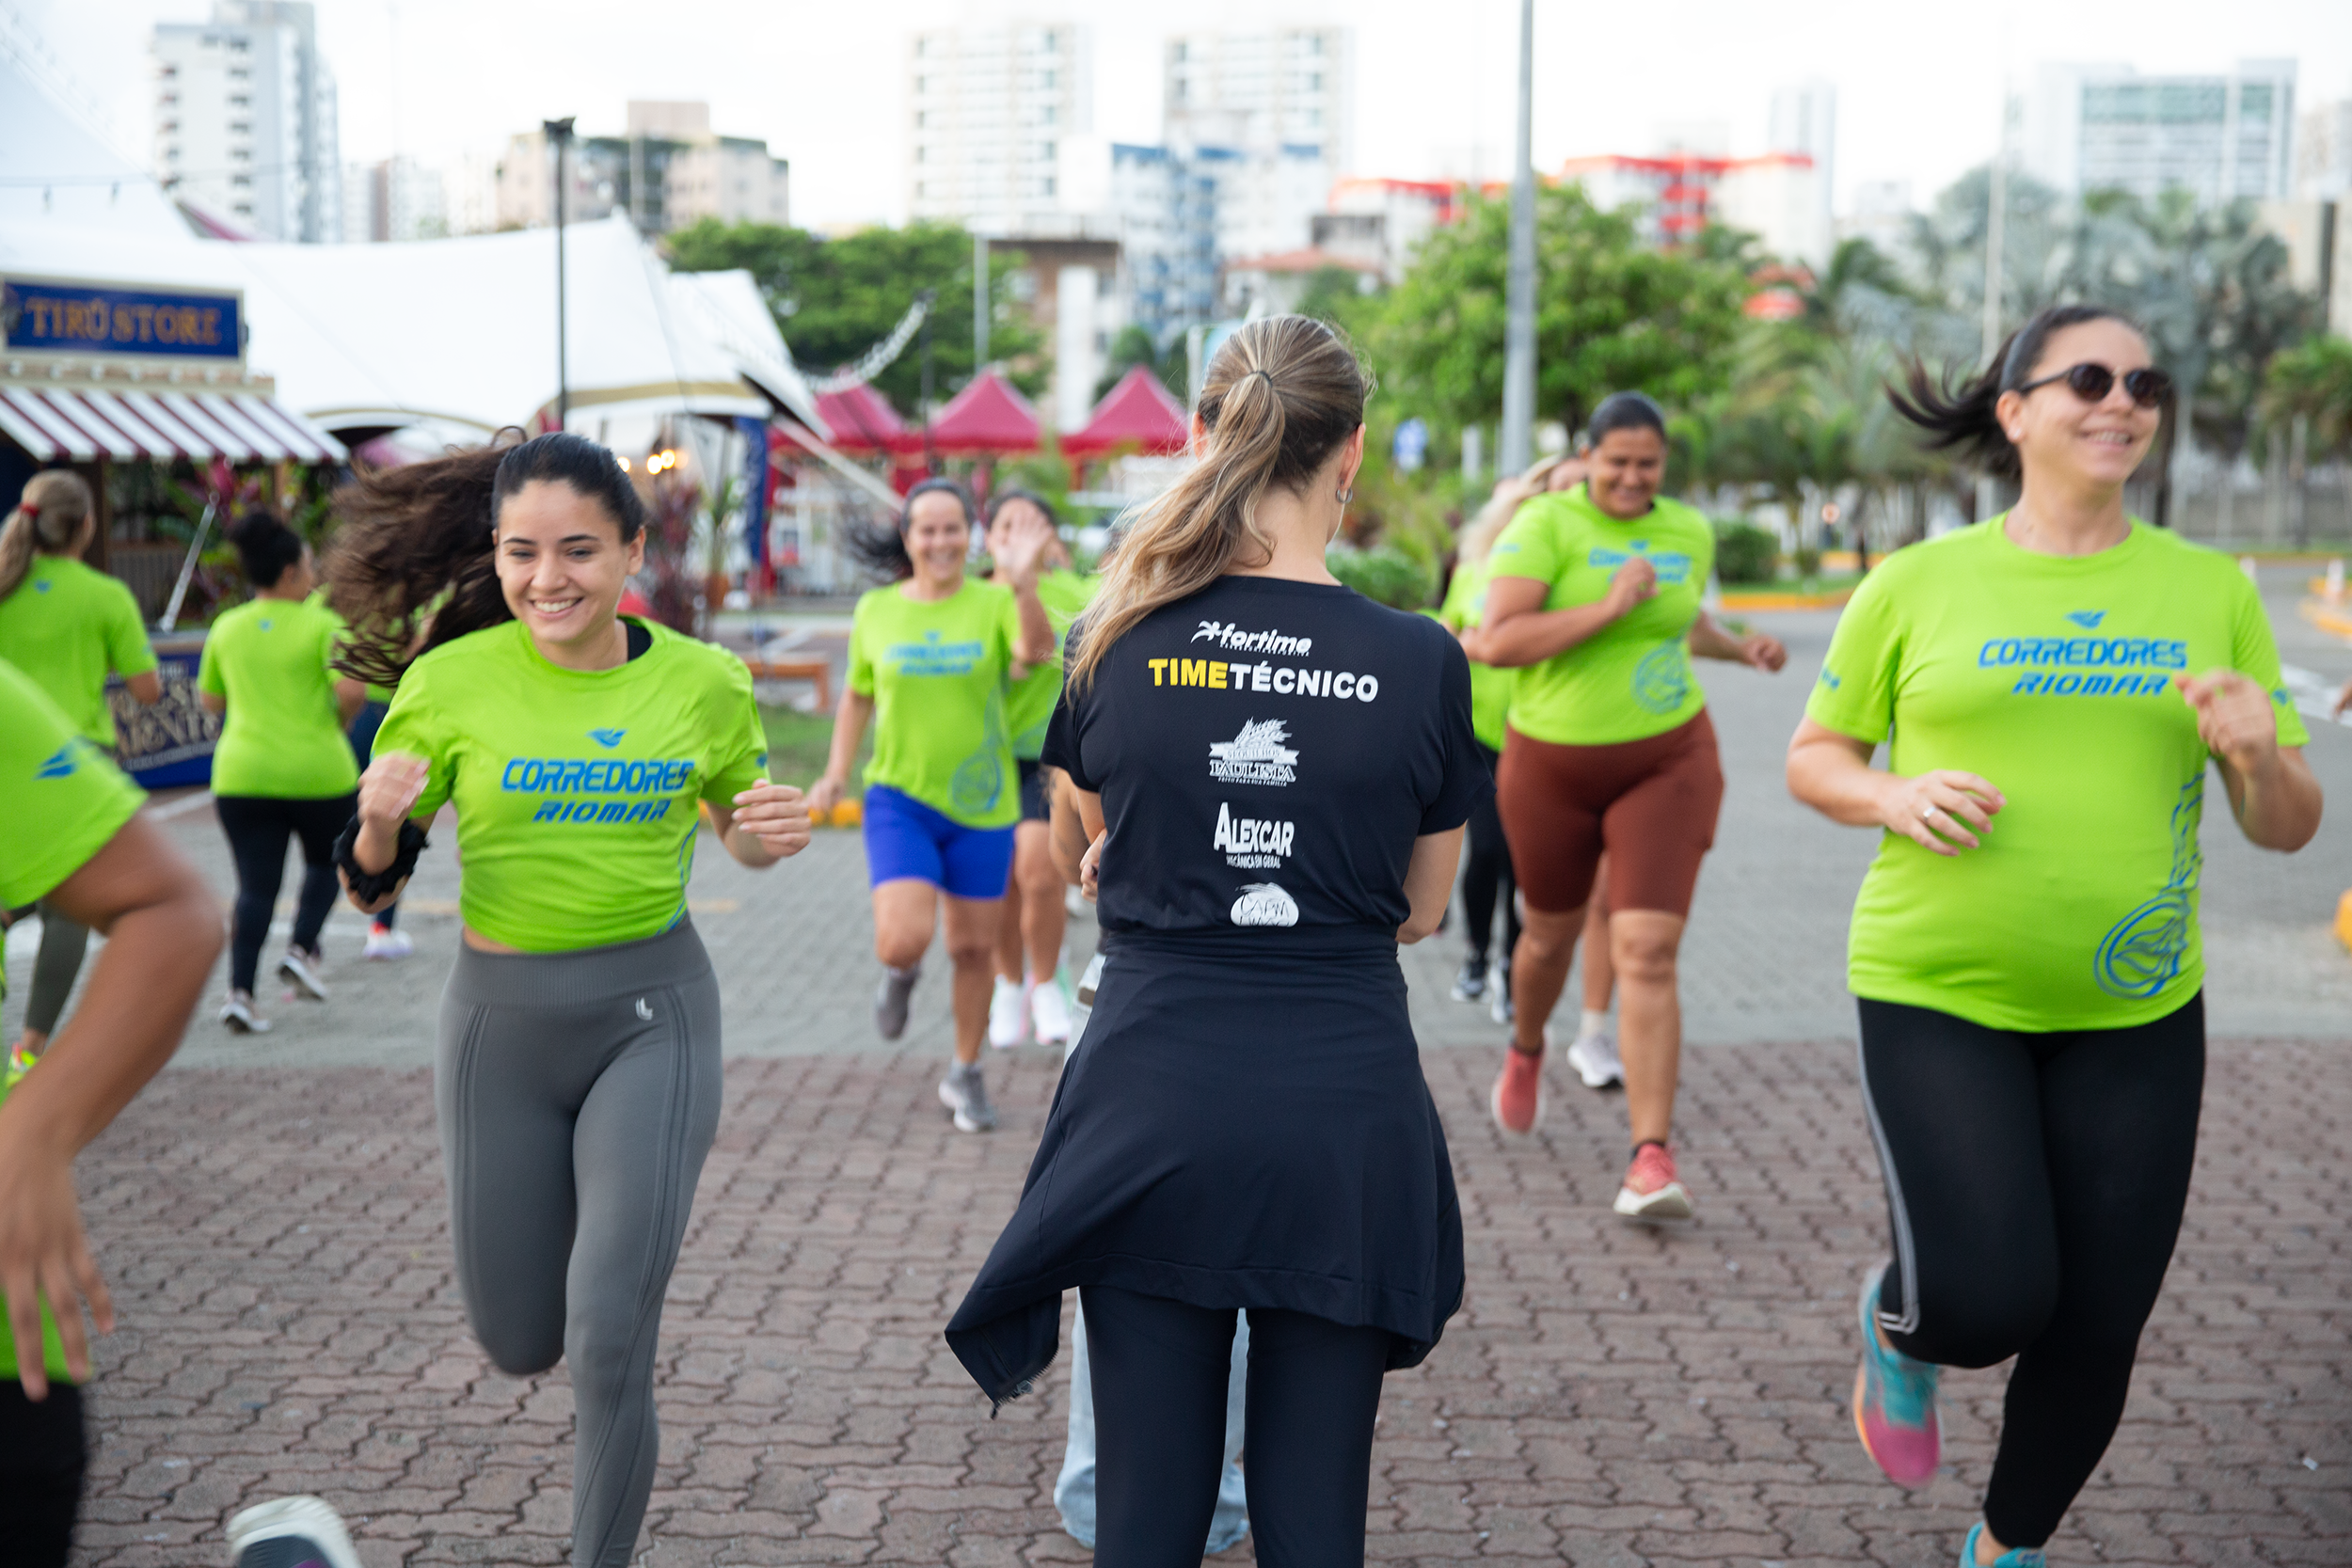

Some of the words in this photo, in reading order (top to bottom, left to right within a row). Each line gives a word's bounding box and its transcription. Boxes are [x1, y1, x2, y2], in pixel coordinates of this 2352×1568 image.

[112, 303, 222, 346] STORE
[1977, 636, 2187, 671] CORREDORES
[2010, 671, 2169, 697] RIOMAR
[501, 755, 696, 794] CORREDORES
[1209, 758, 1296, 783] PAULISTA
[531, 798, 674, 824] RIOMAR
